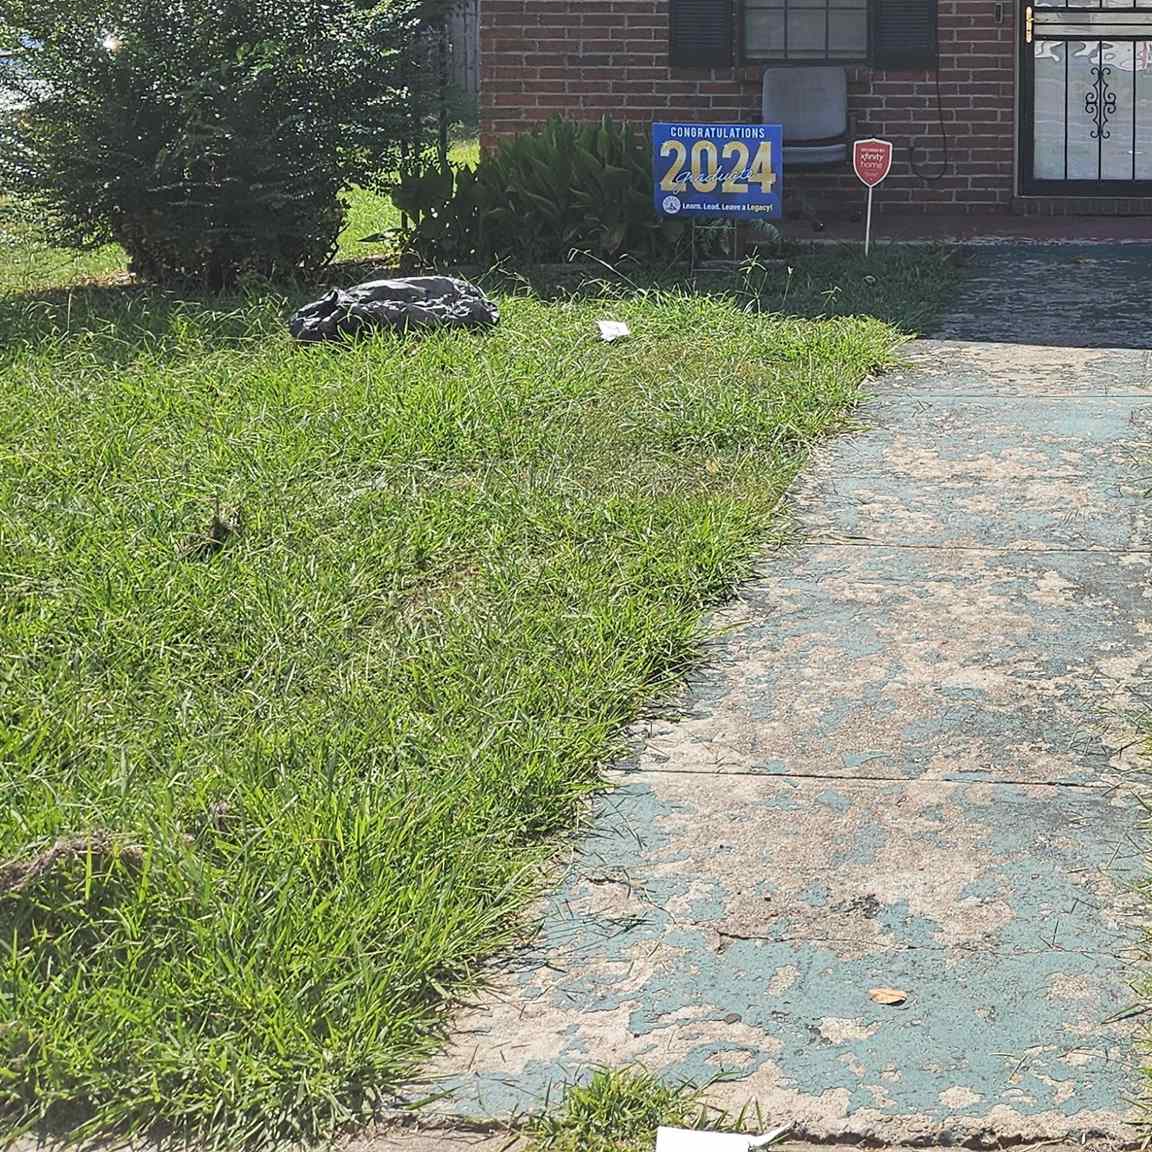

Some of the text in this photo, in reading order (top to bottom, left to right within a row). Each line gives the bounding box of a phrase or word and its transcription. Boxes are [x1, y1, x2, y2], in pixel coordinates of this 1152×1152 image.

[670, 127, 765, 138] CONGRATULATIONS
[660, 140, 776, 193] 2024
[721, 203, 740, 211] Leave
